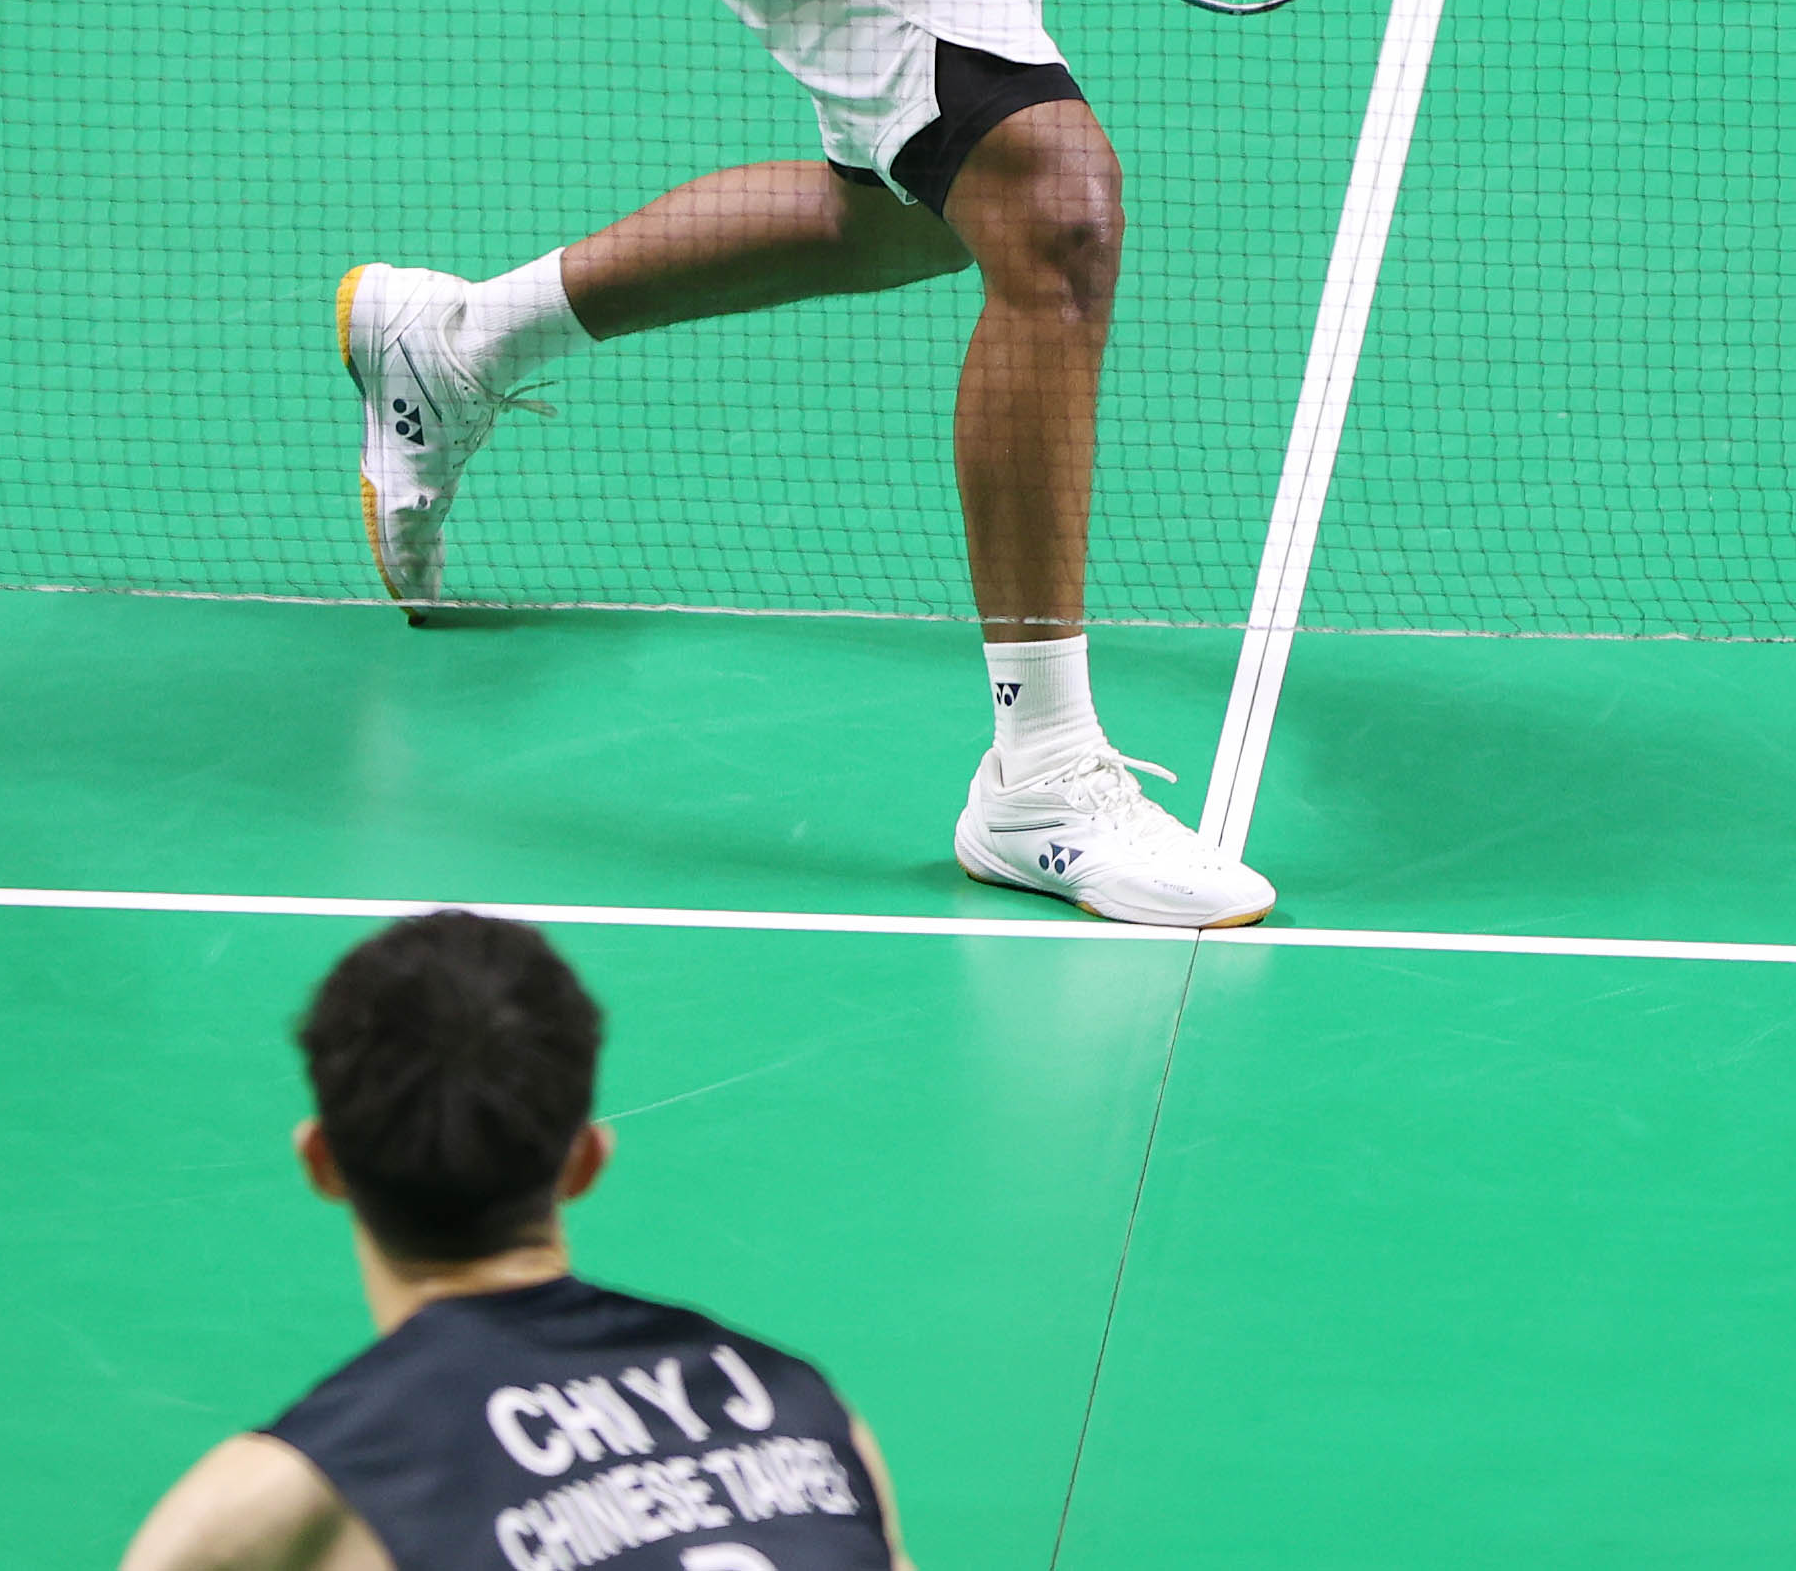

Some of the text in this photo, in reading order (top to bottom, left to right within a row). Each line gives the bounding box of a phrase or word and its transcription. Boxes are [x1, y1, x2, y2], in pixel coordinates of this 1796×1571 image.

[486, 1344, 776, 1477] CHI Y J
[495, 1455, 735, 1571] CHINESE
